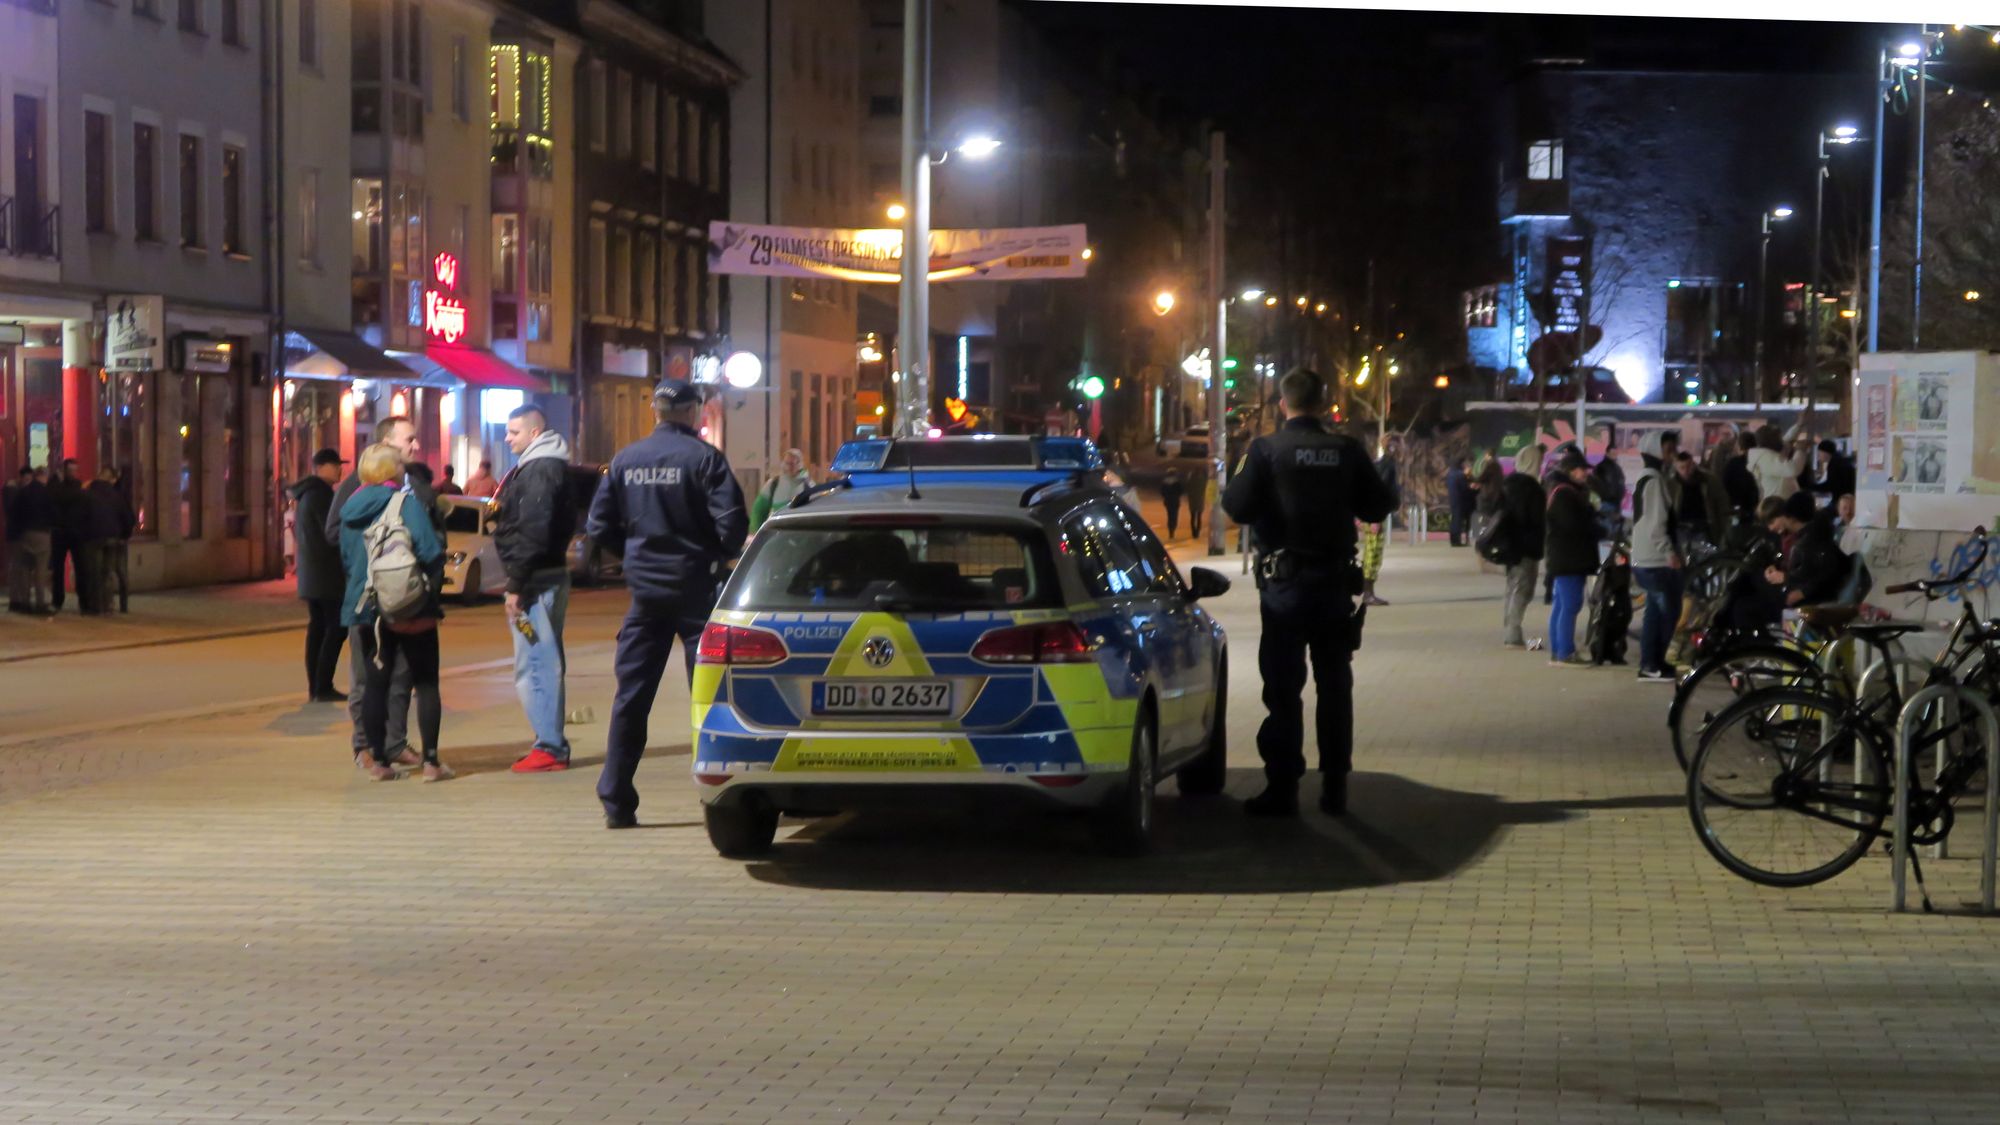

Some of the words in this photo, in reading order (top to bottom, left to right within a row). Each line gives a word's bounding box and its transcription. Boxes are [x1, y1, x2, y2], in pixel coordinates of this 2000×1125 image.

[774, 237, 830, 258] FILMFEST
[1296, 448, 1340, 466] POLIZEI
[624, 467, 682, 486] POLIZEI
[783, 626, 843, 639] POLIZEI
[827, 685, 856, 706] DD
[871, 685, 886, 706] Q
[891, 685, 947, 706] 2637
